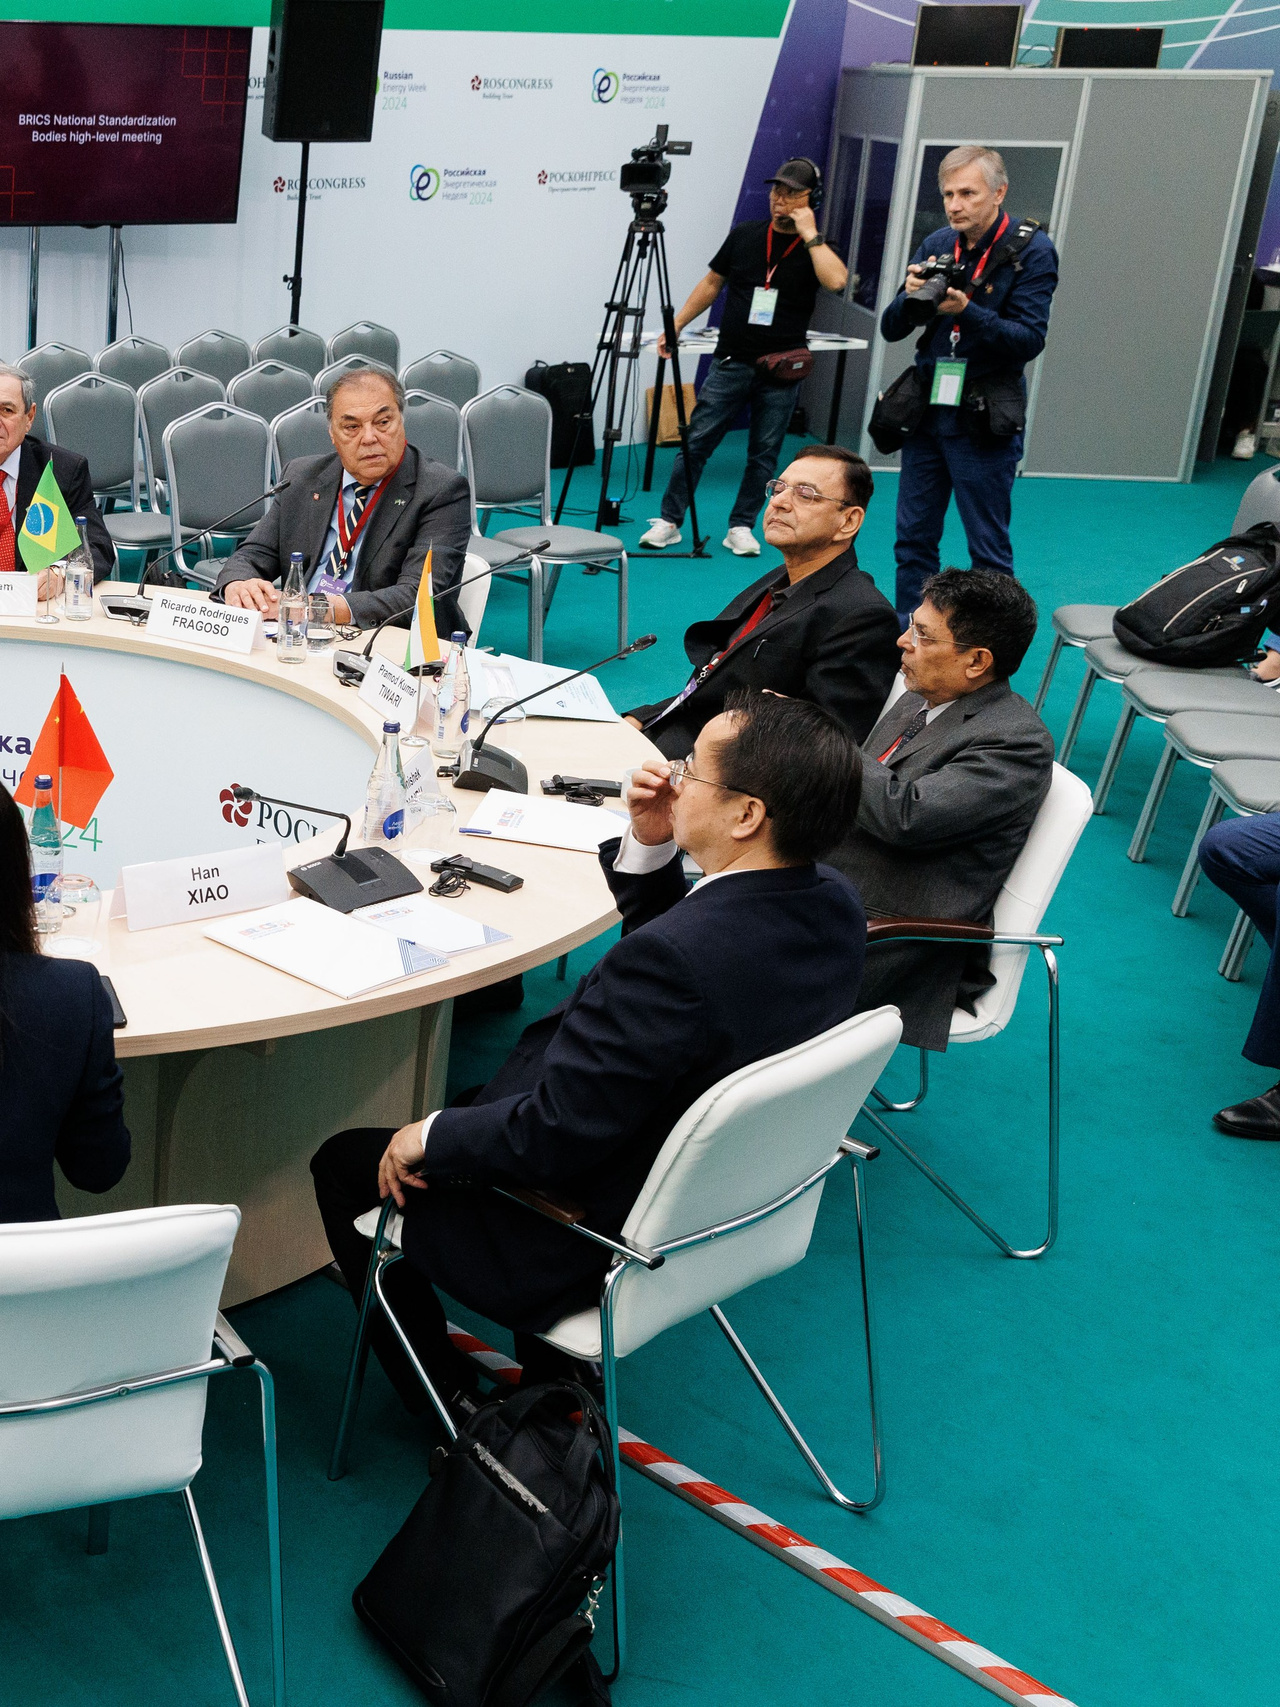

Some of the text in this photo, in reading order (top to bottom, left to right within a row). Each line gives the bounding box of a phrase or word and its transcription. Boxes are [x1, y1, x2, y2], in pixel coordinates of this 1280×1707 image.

[383, 71, 414, 80] Russian
[482, 76, 554, 90] ROSCONGRESS
[622, 72, 661, 82] Российская
[382, 82, 427, 94] Energy Week
[381, 97, 408, 111] 2024
[18, 113, 177, 128] BRICS National Standardization
[31, 130, 163, 145] Bodies high-level meeting
[443, 168, 487, 177] Российская
[549, 170, 616, 183] РОСКОНГРЕСС
[287, 177, 366, 191] ROCONGRESS
[442, 191, 493, 206] Неделя 2024
[160, 598, 197, 617] Ricardo
[198, 605, 250, 627] Rodrigues
[172, 615, 230, 637] FRAGOSO
[377, 664, 418, 698] Pramod Kumar
[378, 683, 403, 708] TIWARI
[191, 864, 220, 882] Han
[188, 884, 230, 906] XIAO
